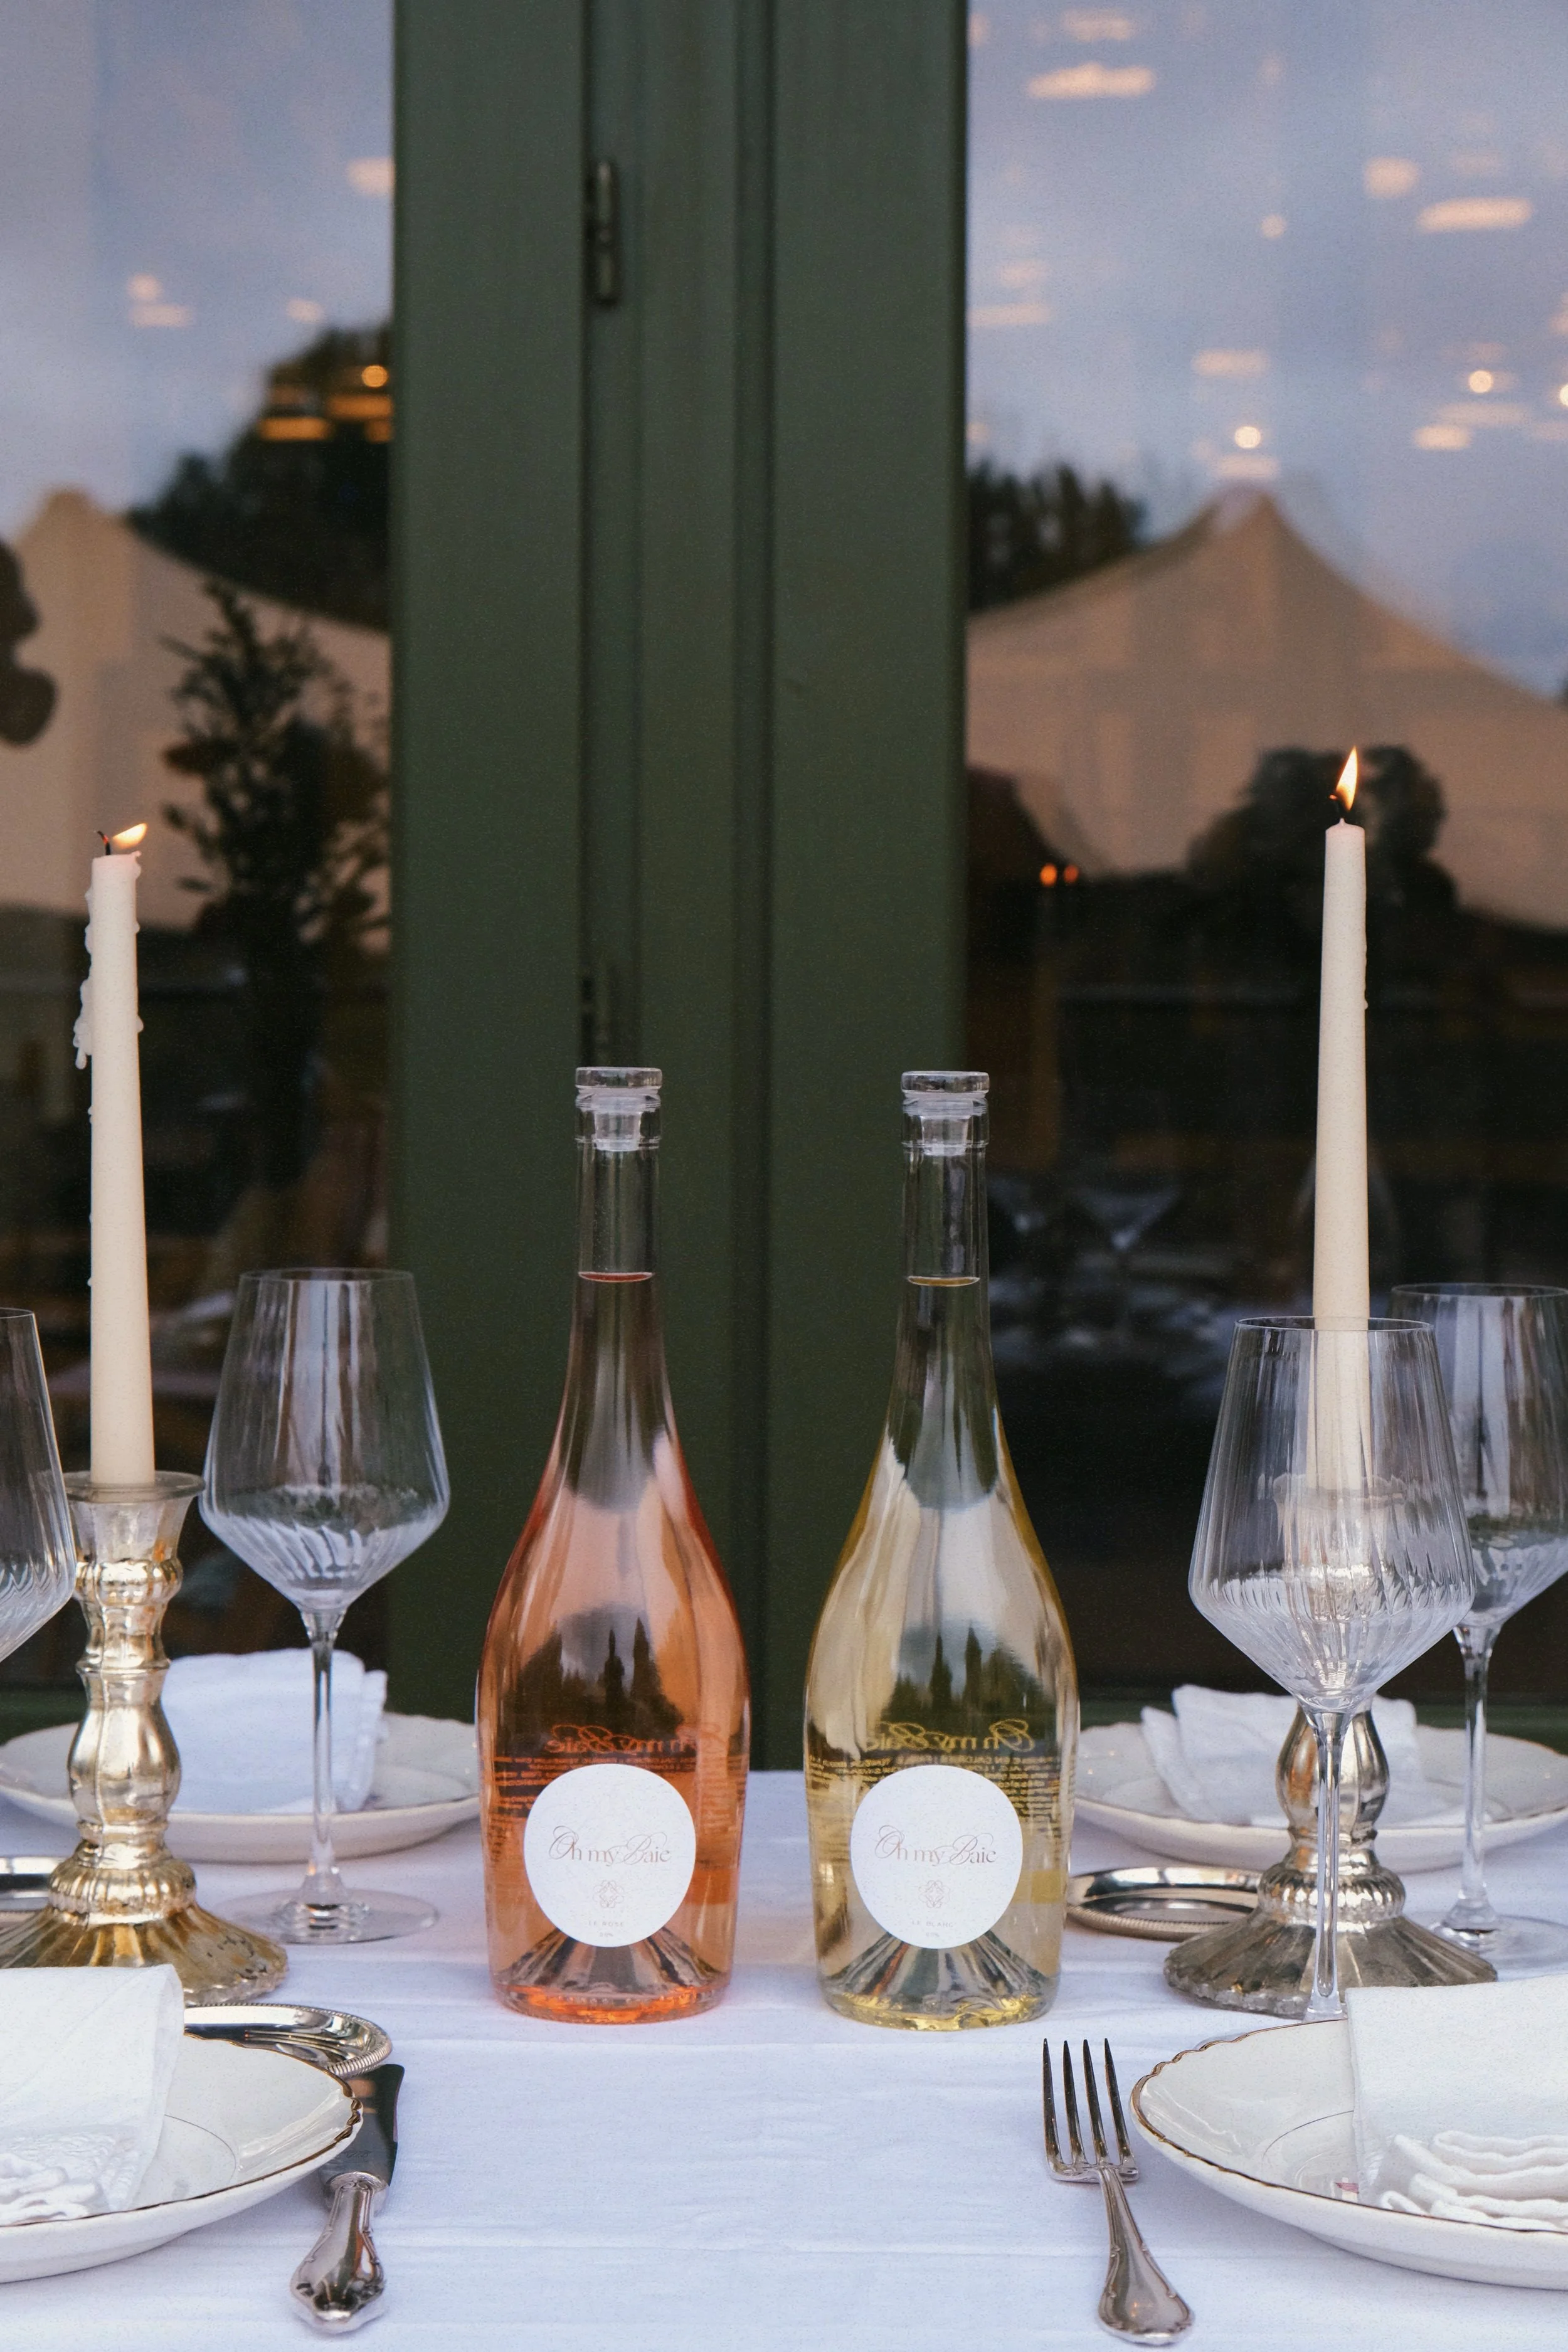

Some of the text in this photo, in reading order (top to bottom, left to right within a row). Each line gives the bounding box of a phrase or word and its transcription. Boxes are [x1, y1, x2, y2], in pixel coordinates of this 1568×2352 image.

[548, 1825, 582, 1861] Oh
[588, 1848, 618, 1867] my
[621, 1831, 672, 1866] Baie
[874, 1825, 997, 1867] Oh my Baie
